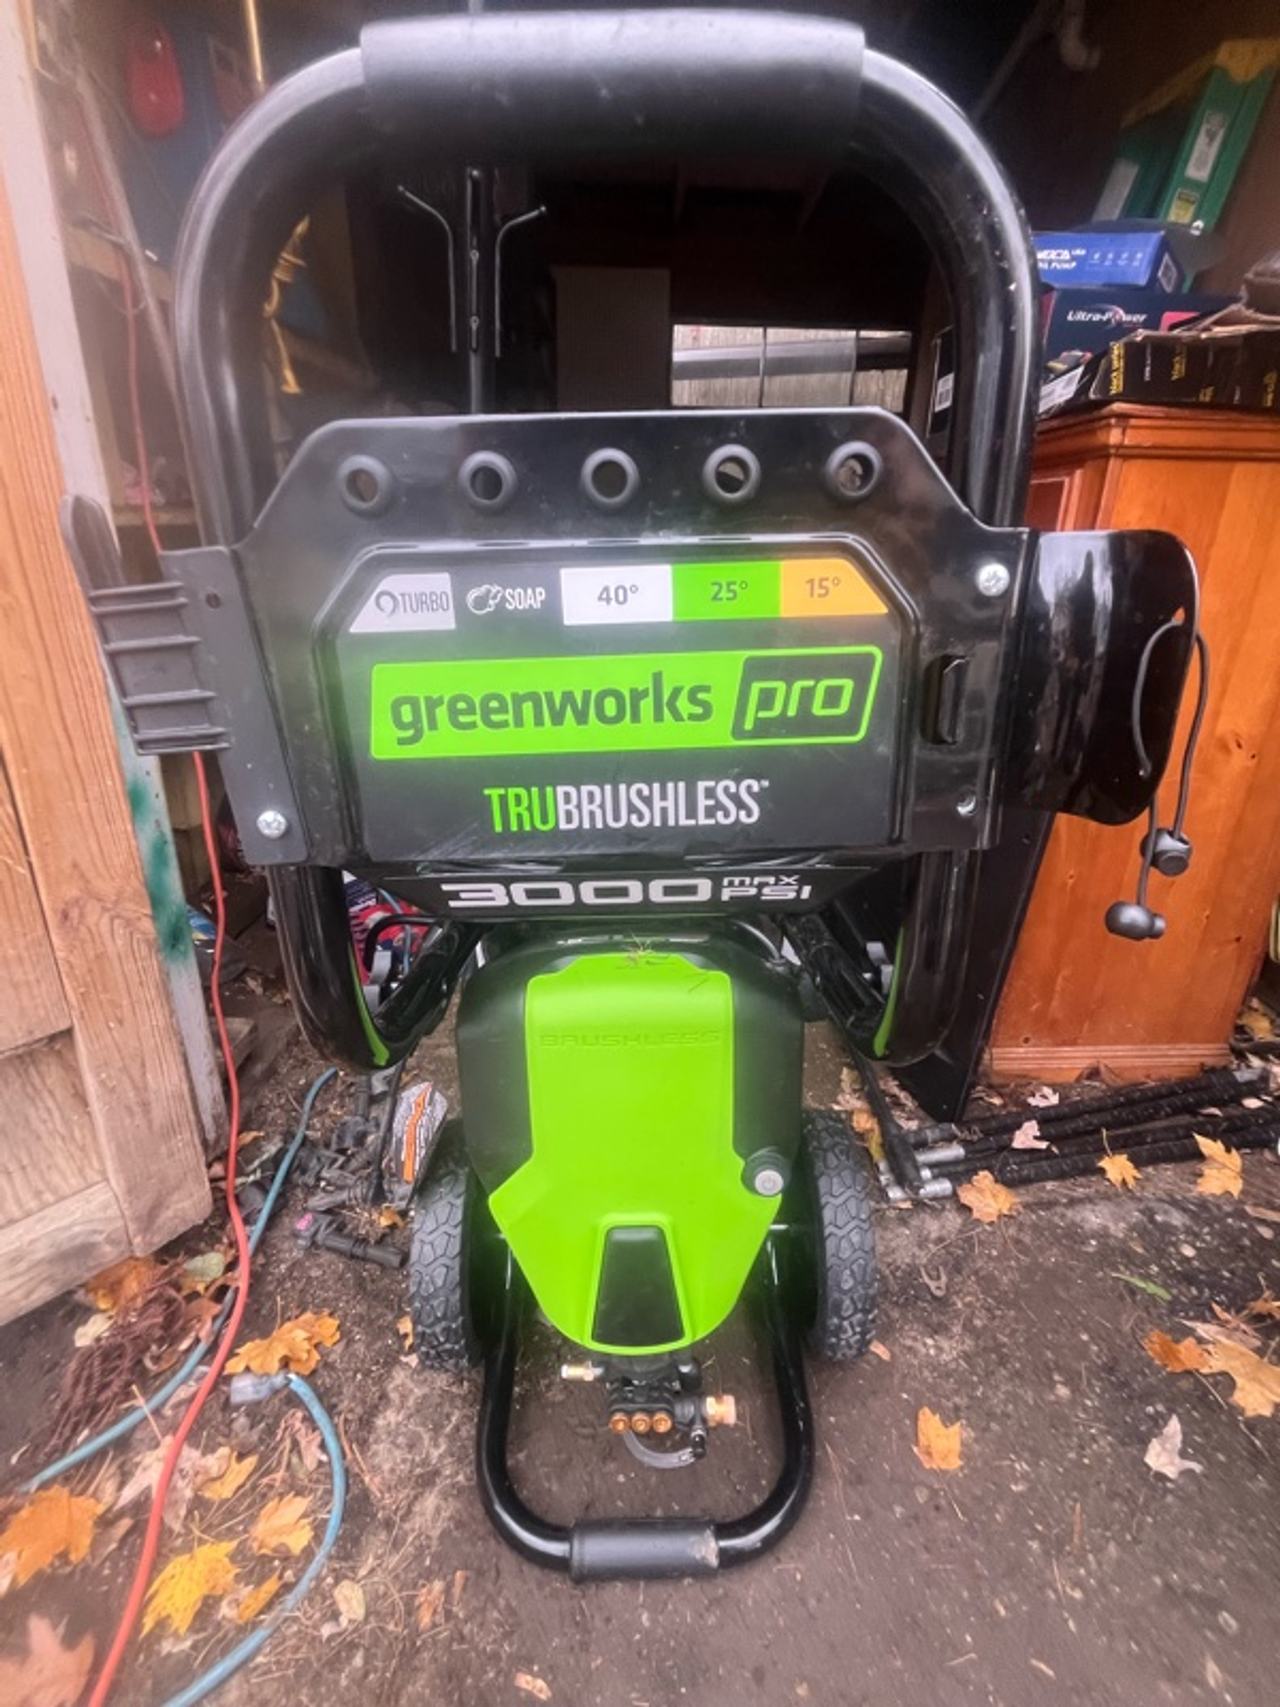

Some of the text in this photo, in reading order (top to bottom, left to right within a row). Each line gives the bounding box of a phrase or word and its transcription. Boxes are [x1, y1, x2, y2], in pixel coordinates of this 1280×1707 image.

[505, 586, 546, 611] SOAP
[597, 584, 639, 606] 40°
[710, 580, 748, 602] 25°
[805, 576, 841, 599] 15°
[399, 591, 450, 615] TURBO
[390, 671, 854, 746] greenworks pro
[722, 874, 800, 887] MAX
[440, 878, 713, 908] 3000
[721, 884, 812, 902] PSI
[540, 1030, 721, 1048] BRUSHLESS
